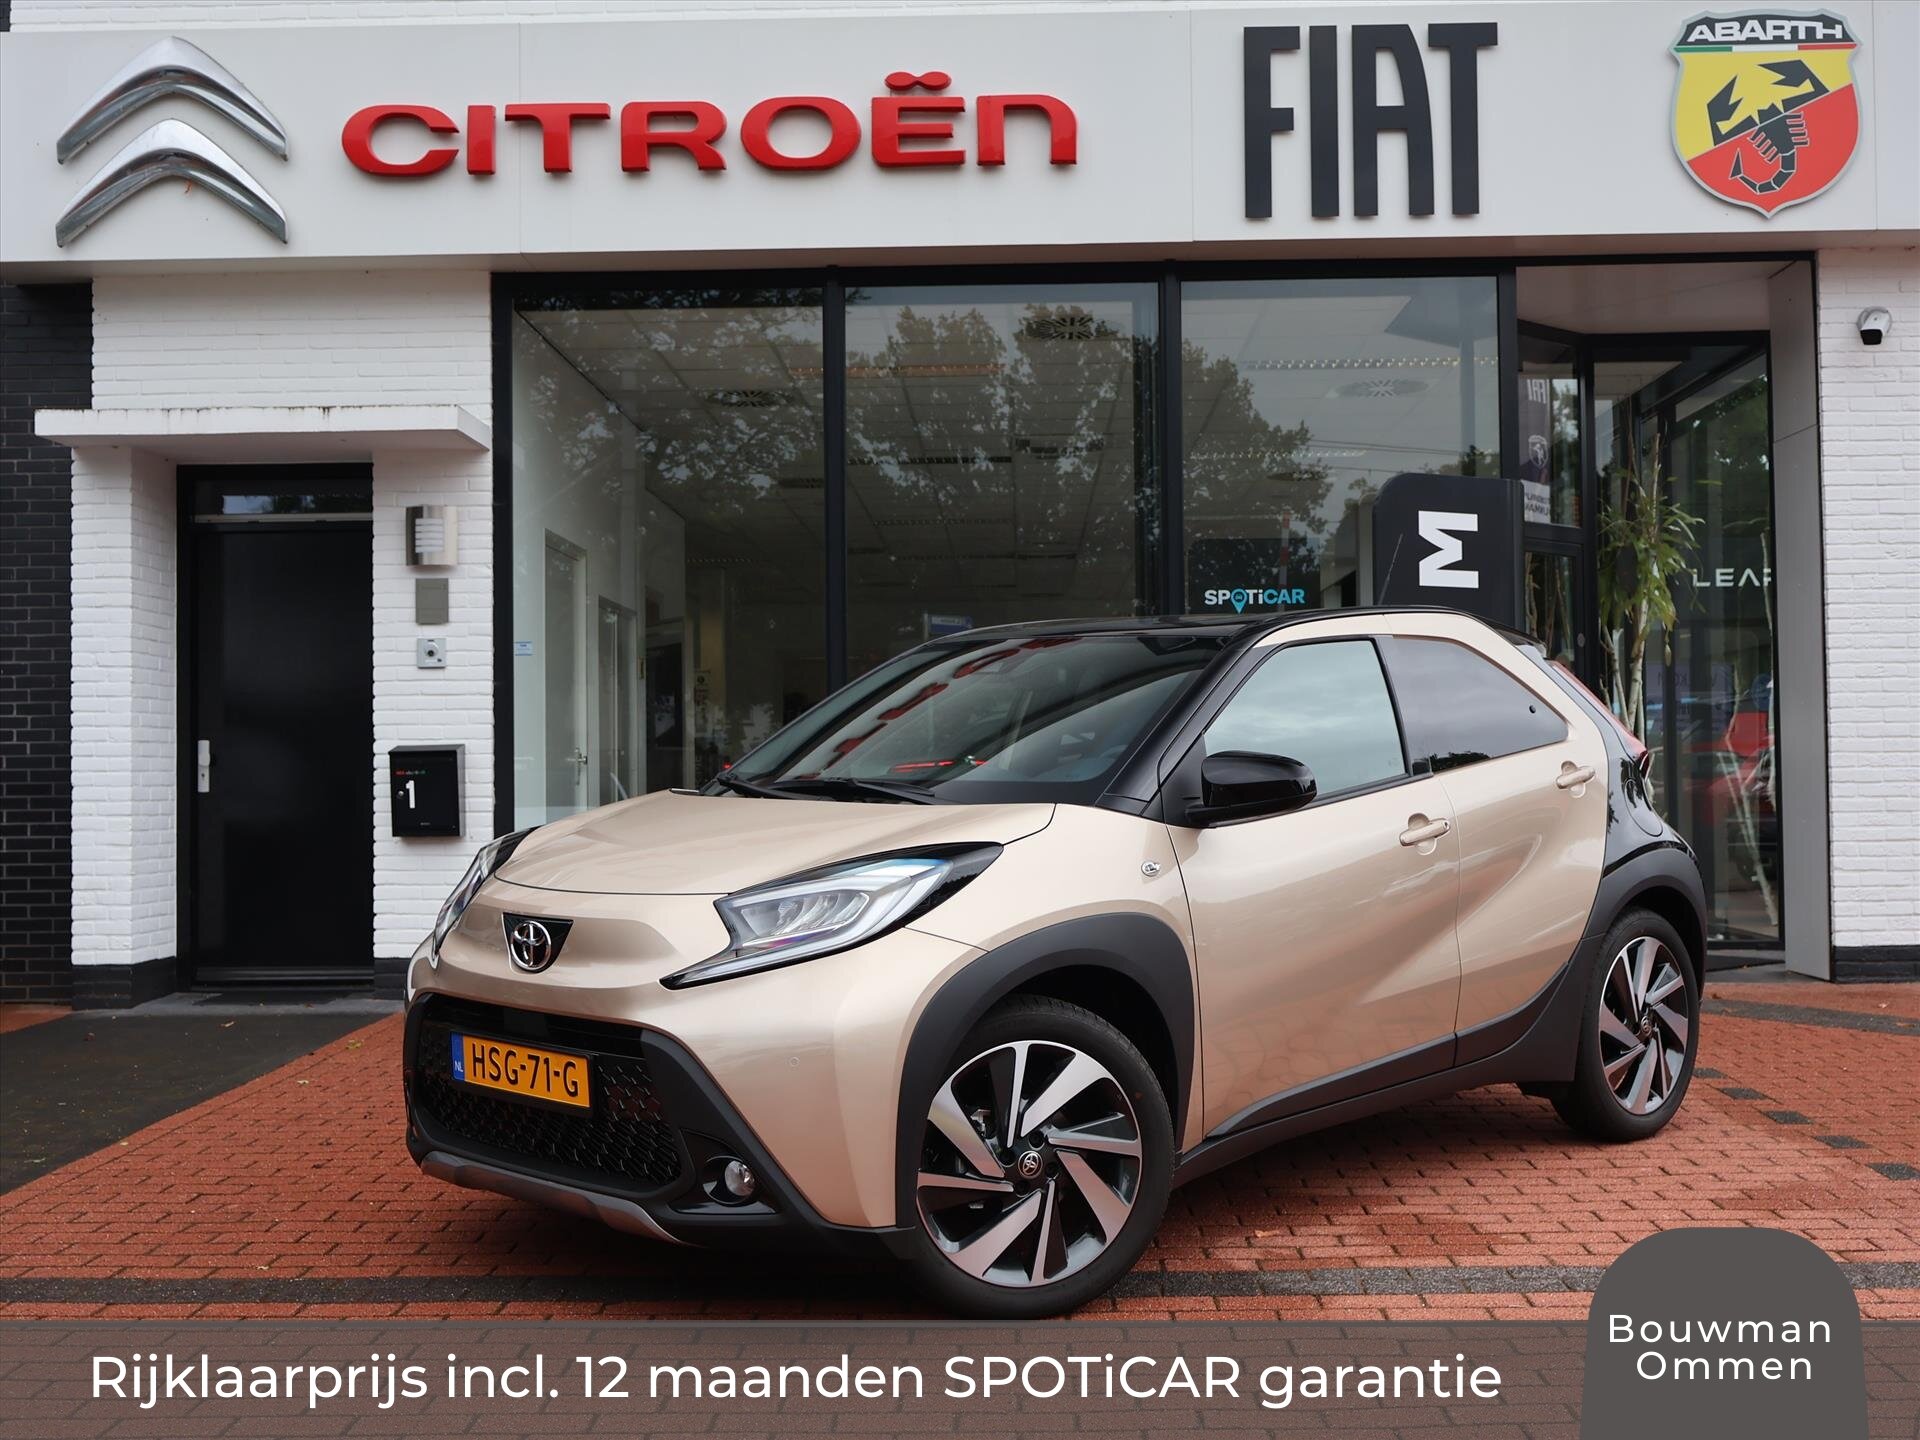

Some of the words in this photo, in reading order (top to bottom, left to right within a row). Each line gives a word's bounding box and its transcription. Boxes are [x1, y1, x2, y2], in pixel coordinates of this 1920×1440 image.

[1687, 19, 1843, 42] ABARTH
[1243, 22, 1498, 219] FIAT
[405, 780, 416, 809] 1
[454, 1060, 464, 1073] NL
[472, 1042, 579, 1098] HSG-71-G
